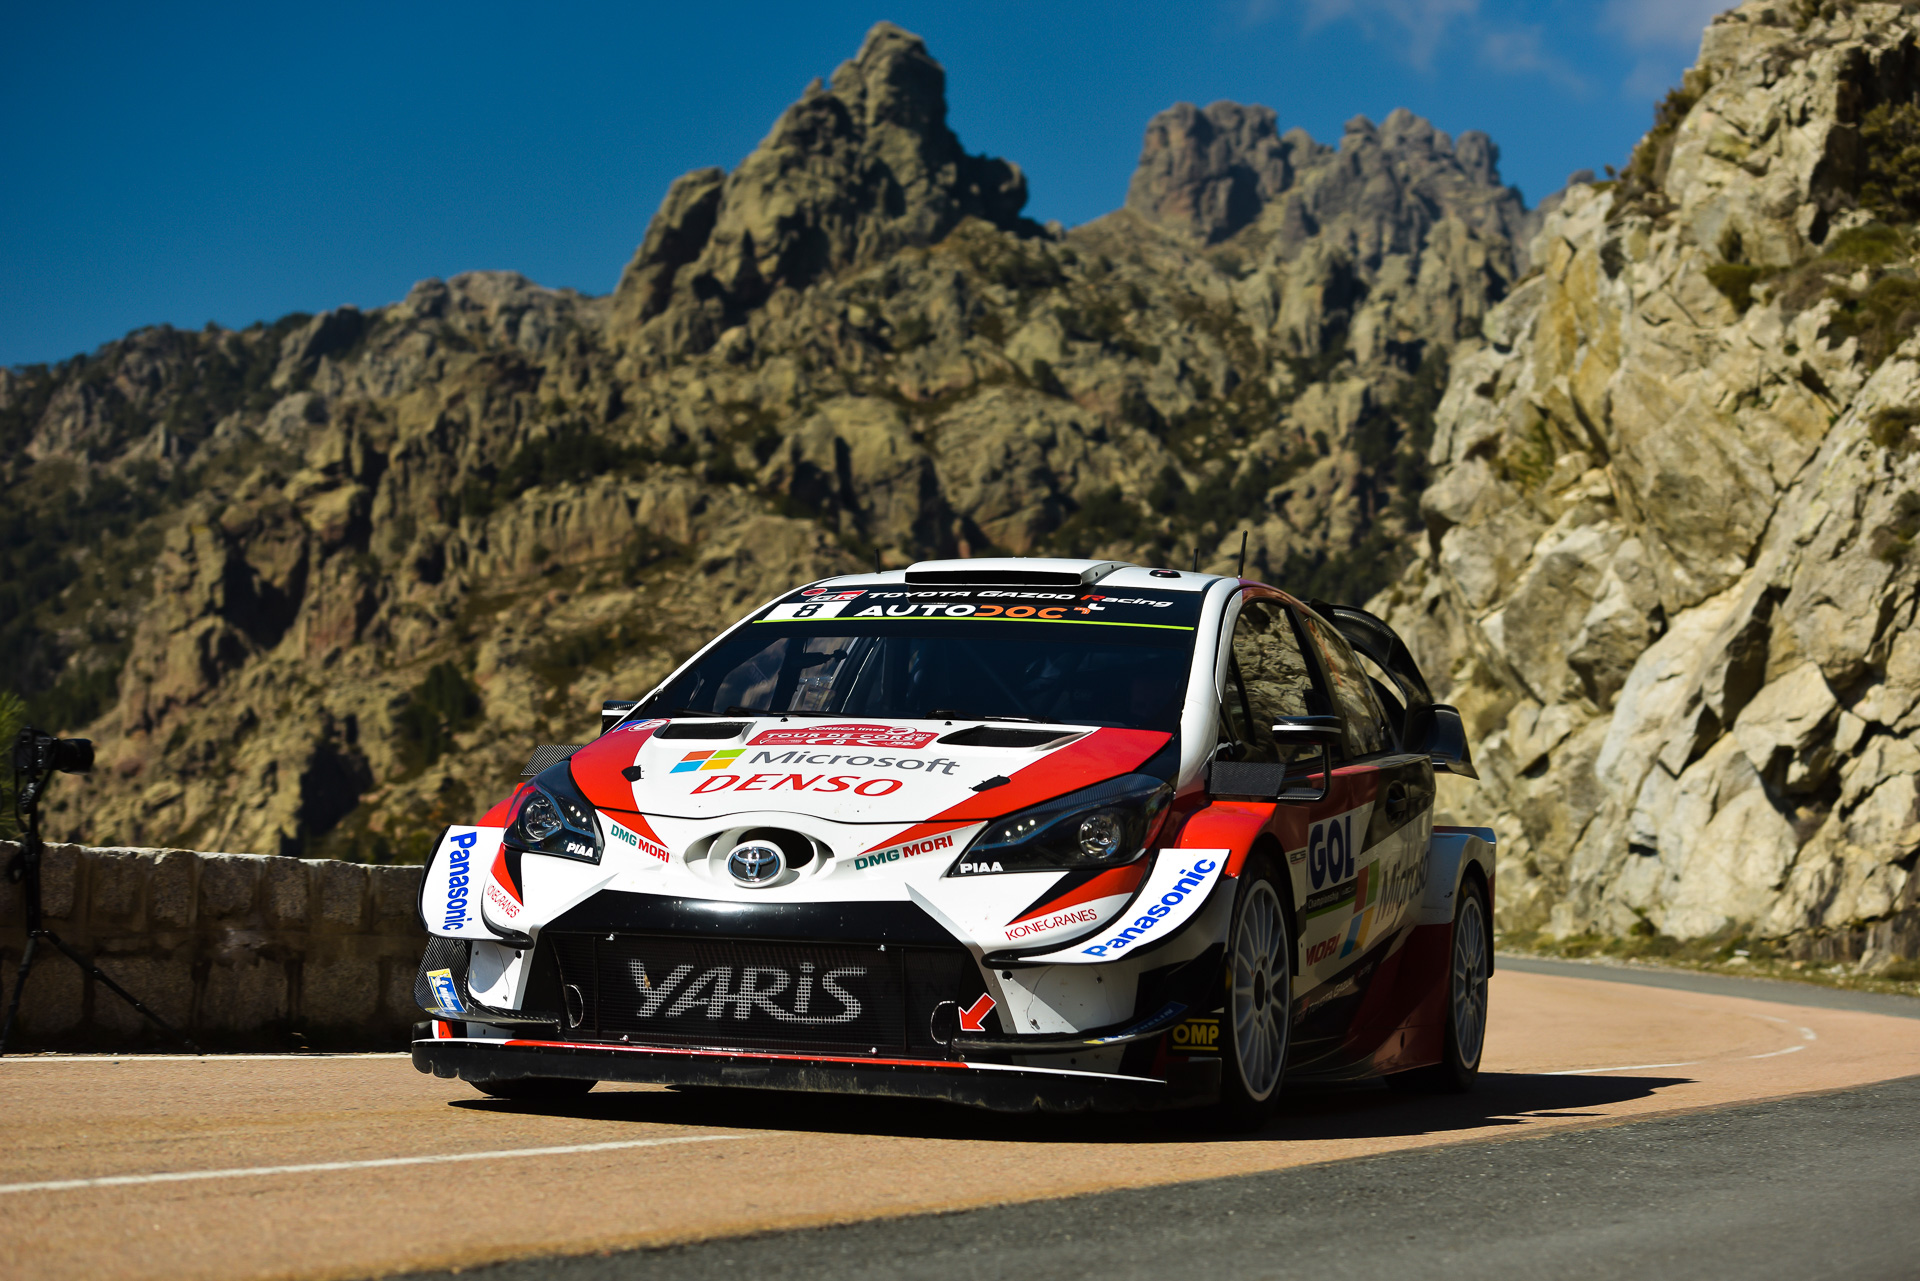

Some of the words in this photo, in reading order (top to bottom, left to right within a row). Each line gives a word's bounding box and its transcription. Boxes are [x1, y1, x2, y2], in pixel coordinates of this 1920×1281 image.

[792, 603, 824, 618] 8
[868, 590, 972, 599] TOYOTA
[1080, 594, 1174, 608] Racing
[853, 603, 1068, 619] AUTODOC
[860, 733, 927, 742] CORSE
[749, 750, 960, 775] Microsoft
[690, 773, 903, 797] DENSO
[566, 842, 594, 858] PIAA
[610, 823, 637, 847] DMG
[638, 838, 670, 864] MORI
[854, 849, 900, 871] DMG
[902, 834, 954, 859] MORI
[959, 861, 1004, 874] PIAA
[442, 831, 477, 931] Panasonic
[1081, 858, 1216, 957] Panasonic
[1004, 908, 1098, 941] KONECRANES
[1172, 1023, 1220, 1046] OMP
